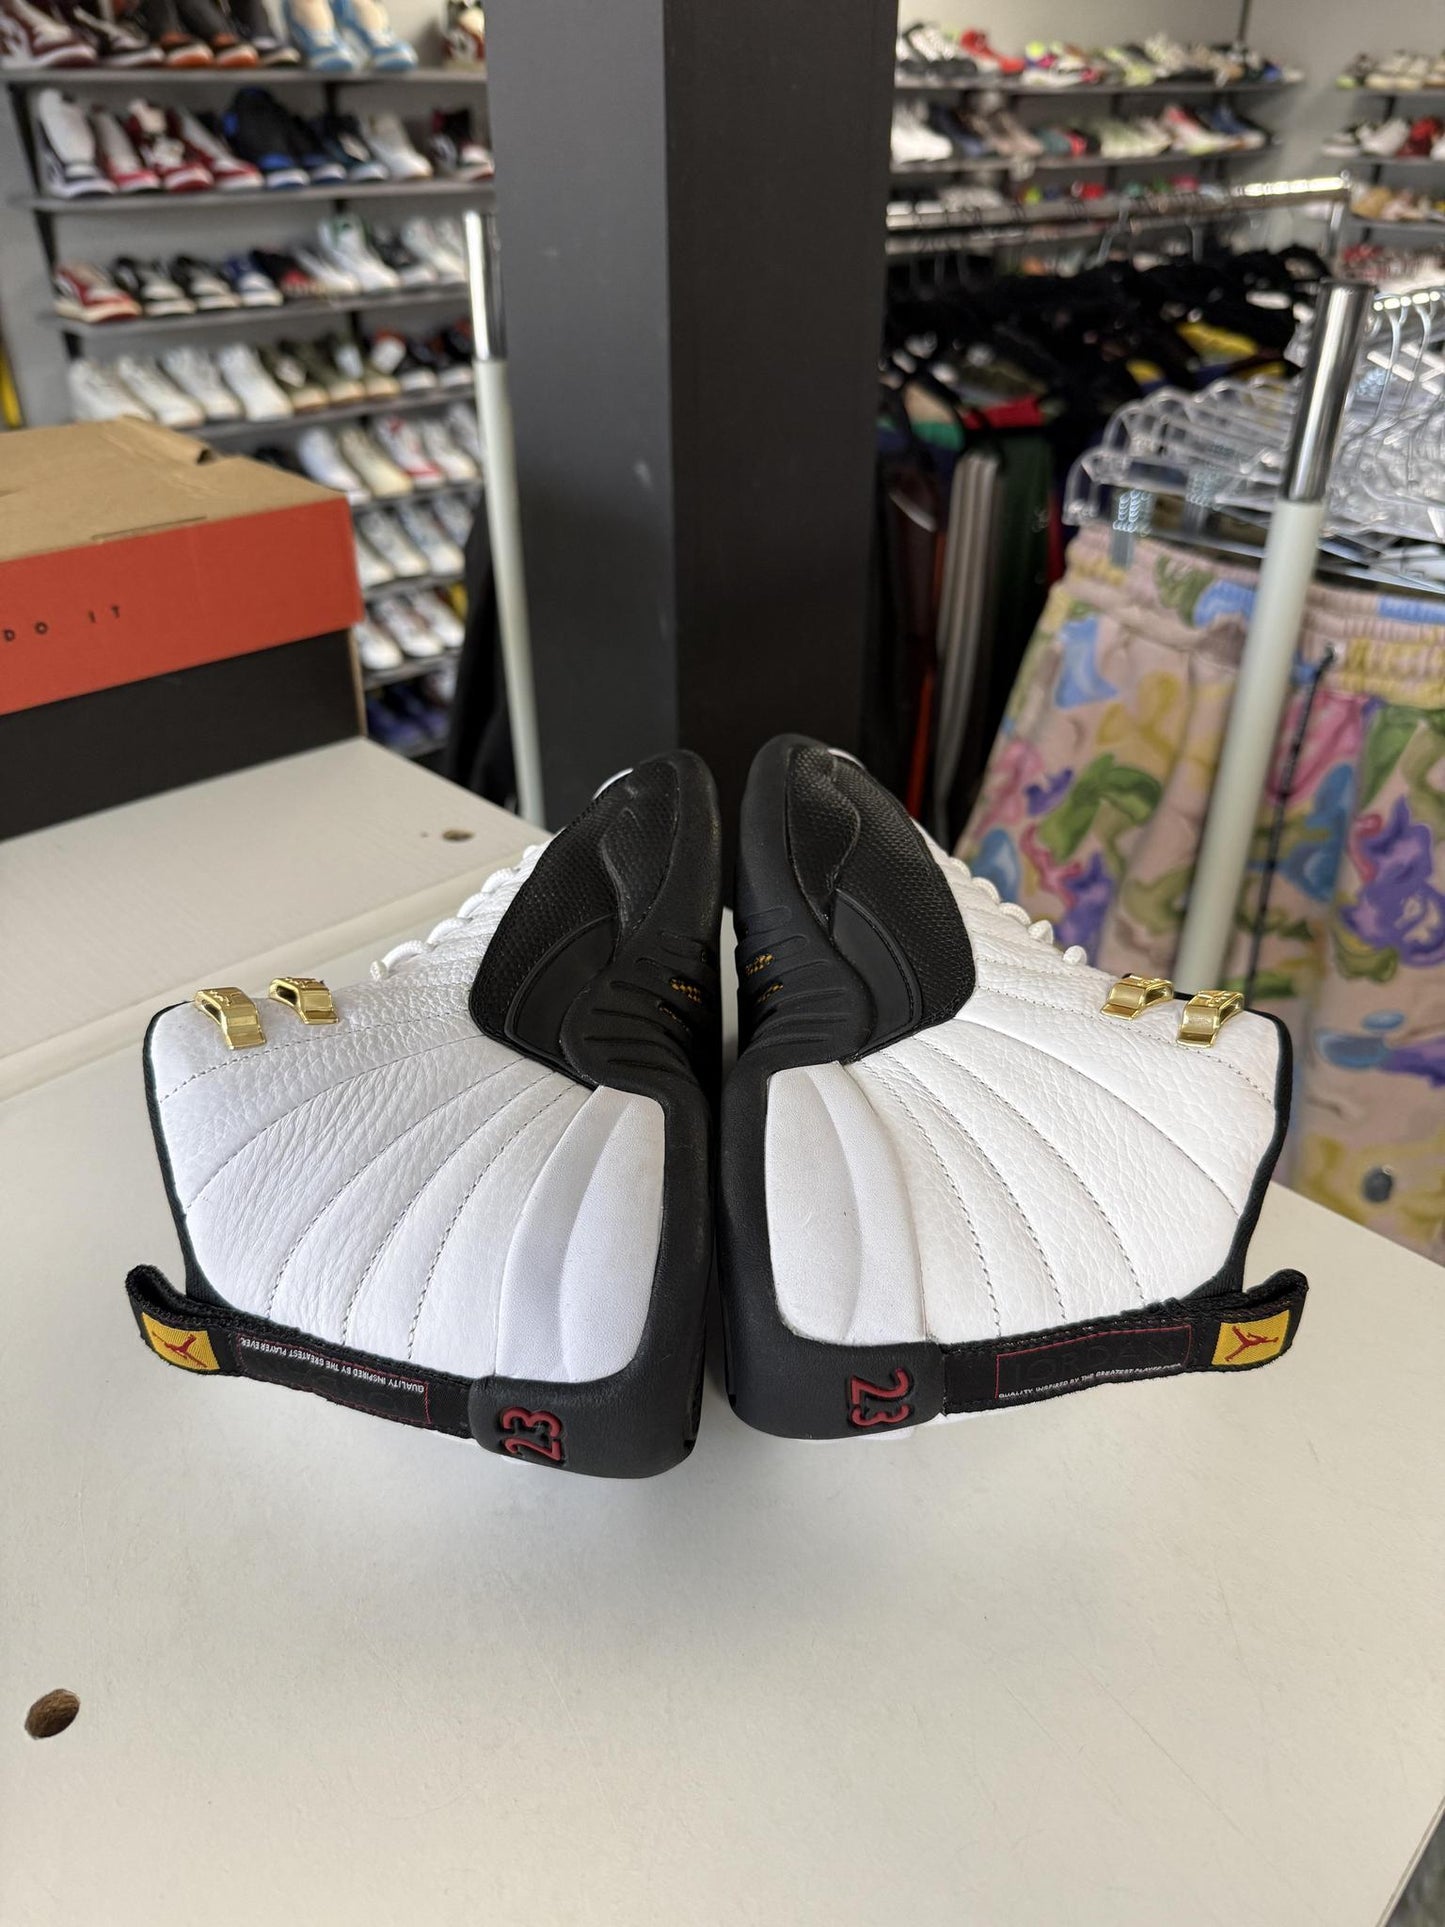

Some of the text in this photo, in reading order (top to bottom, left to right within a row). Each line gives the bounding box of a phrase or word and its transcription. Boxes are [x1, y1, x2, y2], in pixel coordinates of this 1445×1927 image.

[3, 605, 120, 642] DO IT
[260, 1342, 287, 1356] PLAYER
[289, 1349, 325, 1366] GREATEST
[325, 1360, 340, 1372] THE
[341, 1365, 352, 1375] BY
[353, 1368, 386, 1385] INSPIRED
[388, 1378, 425, 1393] QUALITY
[998, 1388, 1034, 1398] QUALITY
[1035, 1380, 1069, 1392] INSPIRED
[1069, 1377, 1080, 1385] BY
[851, 1368, 909, 1426] 23
[503, 1406, 561, 1461] 23
